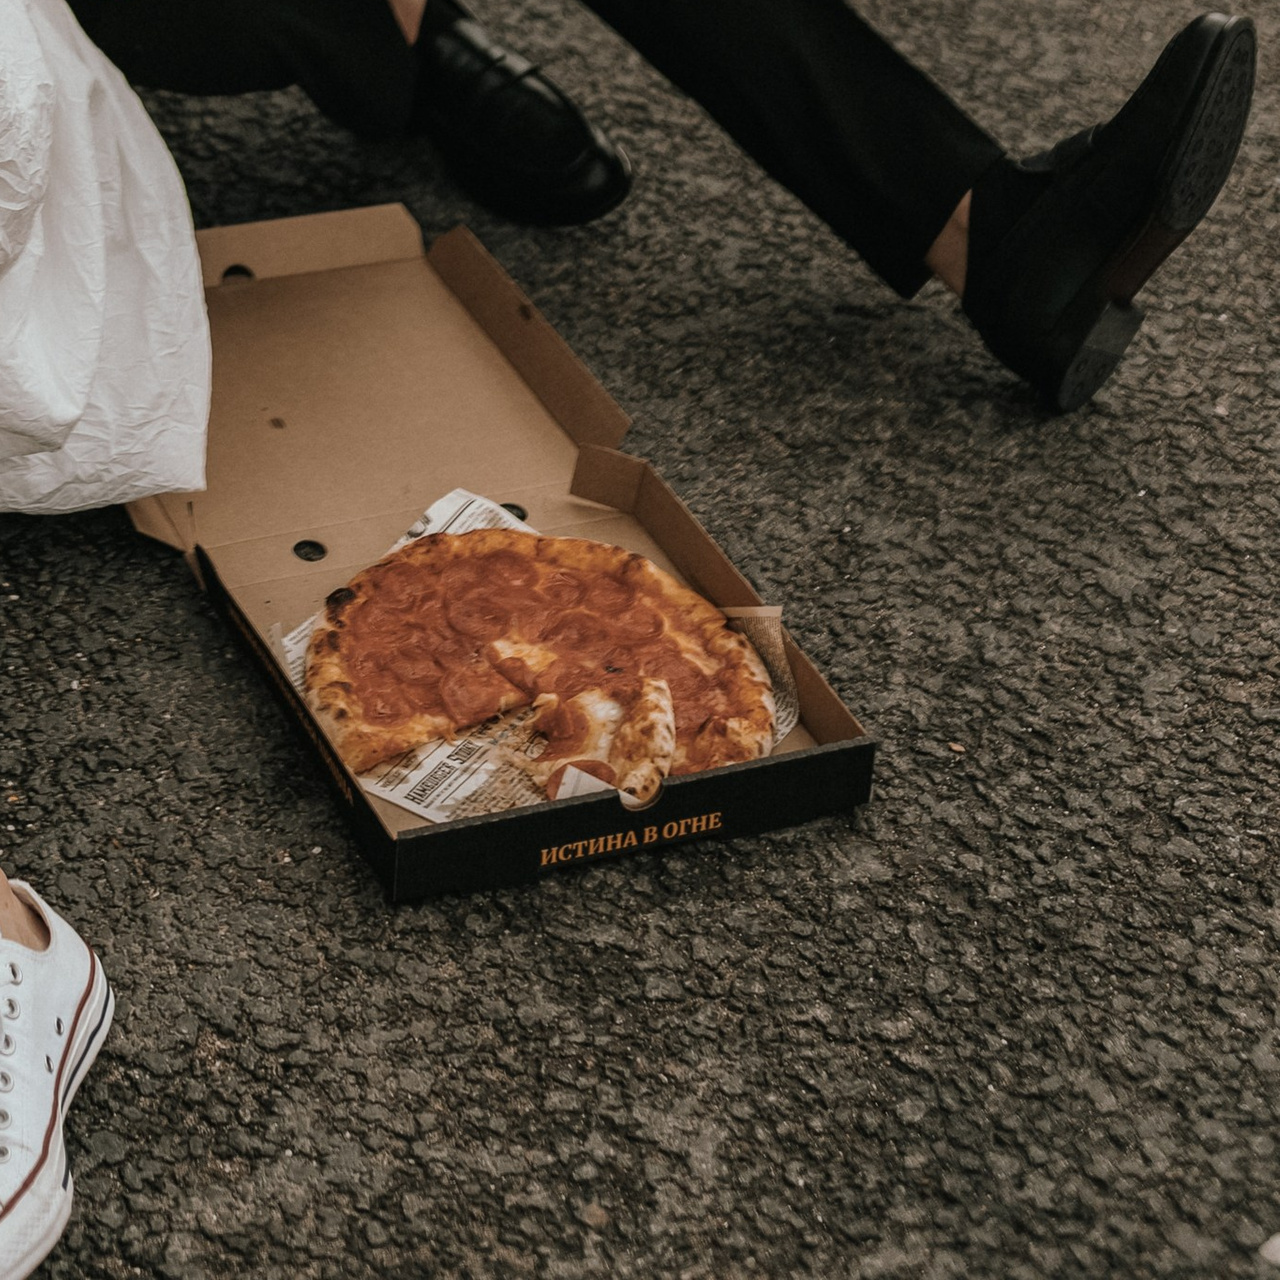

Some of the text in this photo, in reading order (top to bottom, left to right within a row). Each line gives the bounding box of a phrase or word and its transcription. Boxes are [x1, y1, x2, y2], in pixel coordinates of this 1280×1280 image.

[404, 760, 458, 806] HAMBURGER
[446, 739, 484, 766] STORY
[540, 812, 723, 866] ИСТИНА В ОГНЕ
